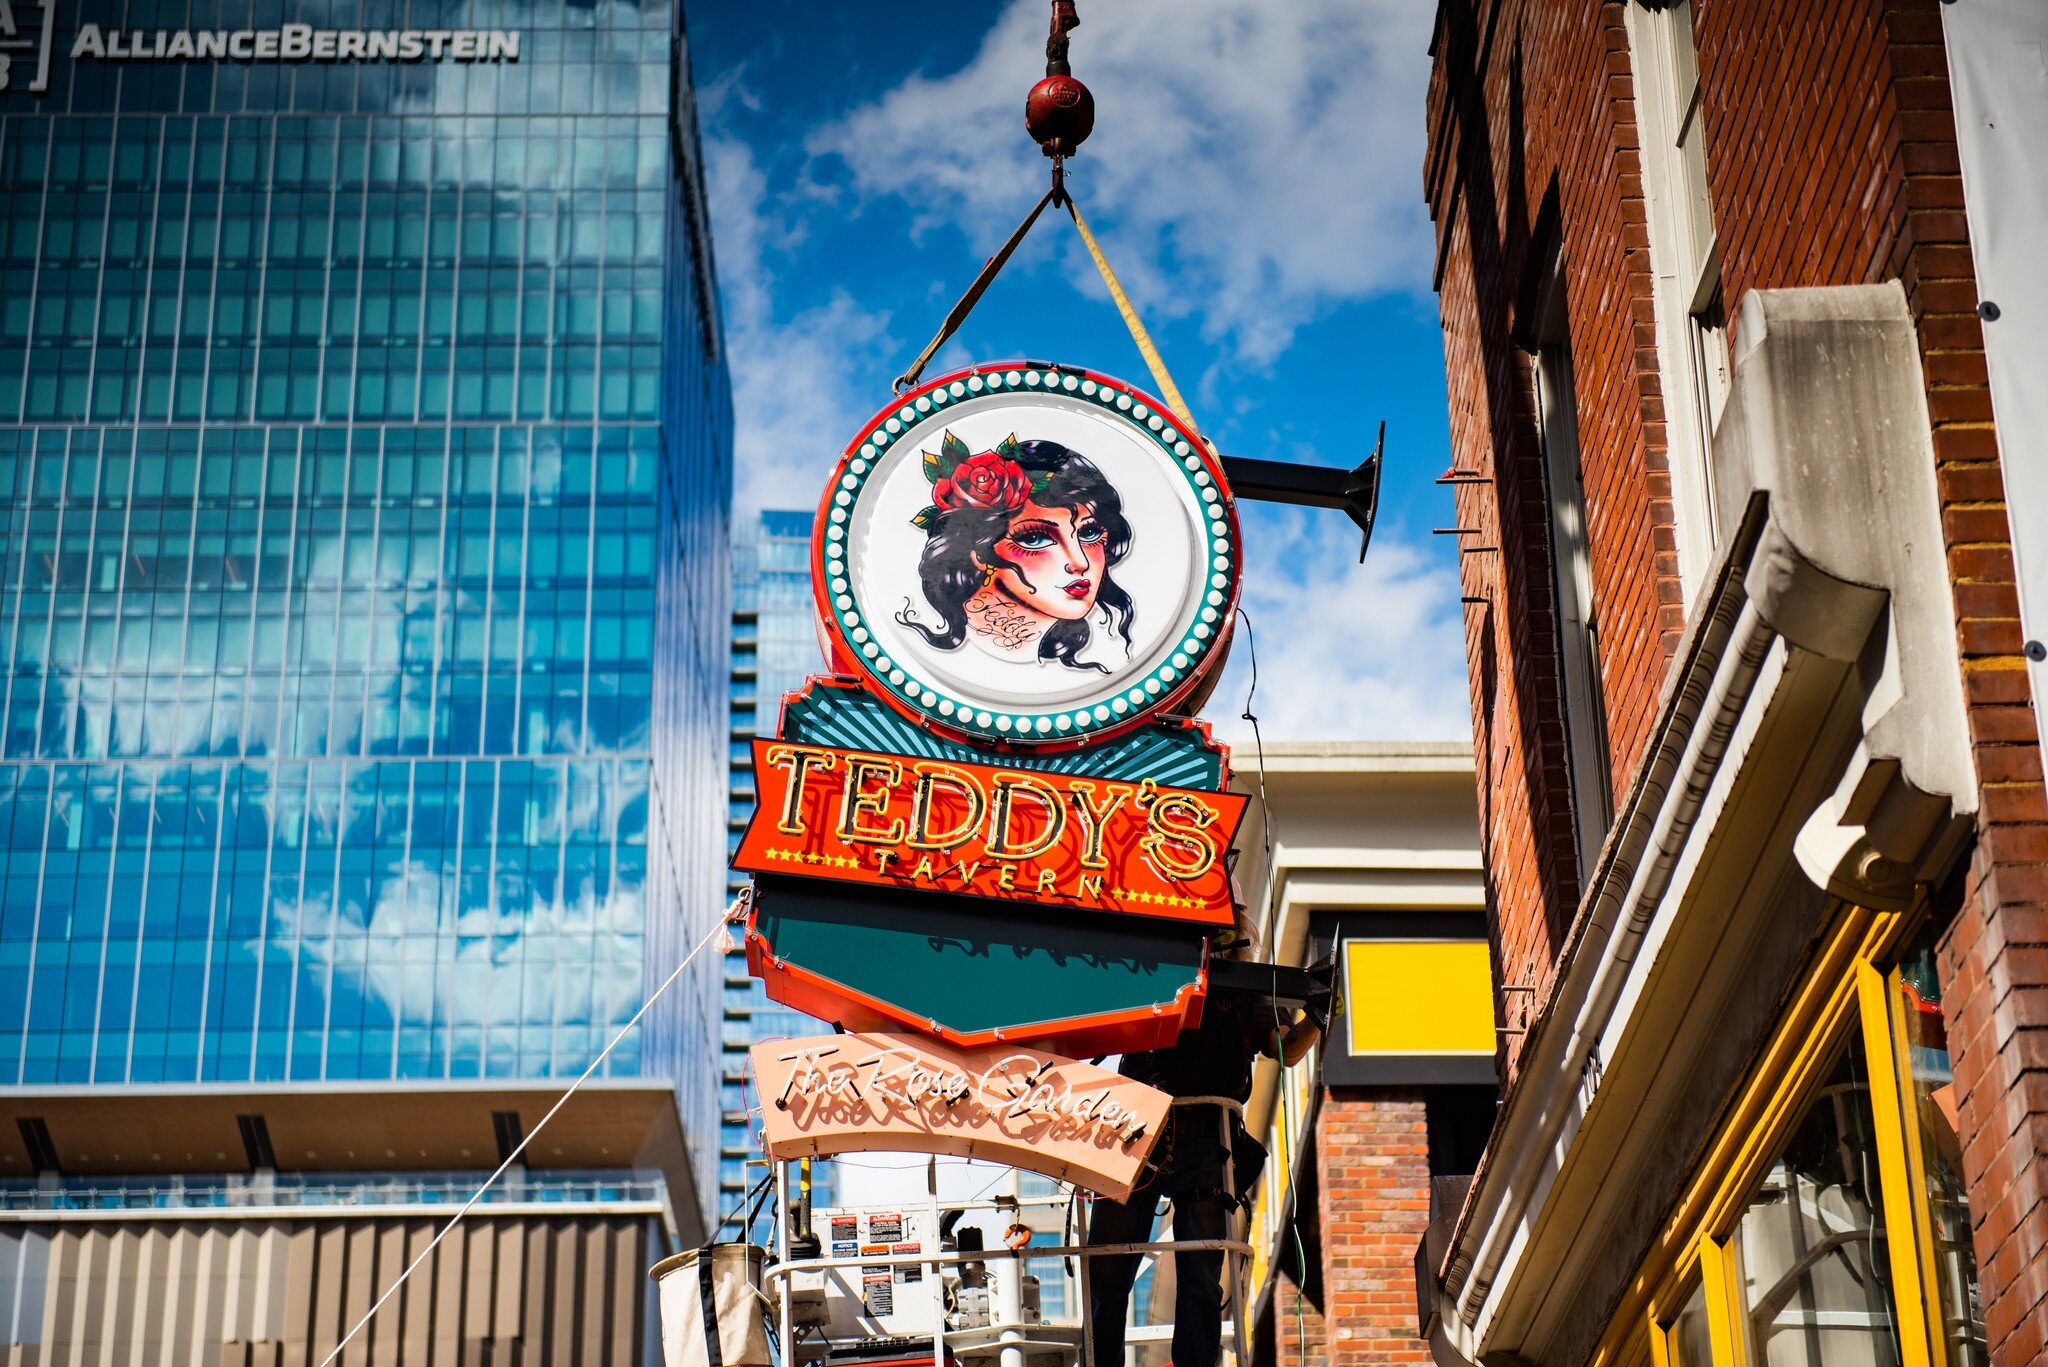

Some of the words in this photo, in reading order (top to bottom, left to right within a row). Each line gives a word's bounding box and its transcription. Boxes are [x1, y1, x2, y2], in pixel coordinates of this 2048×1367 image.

[766, 745, 1218, 878] TEDDY'S
[874, 848, 1102, 899] TAVERN
[776, 1045, 853, 1106] The
[857, 1047, 970, 1109] Rose
[977, 1054, 1147, 1132] Garden
